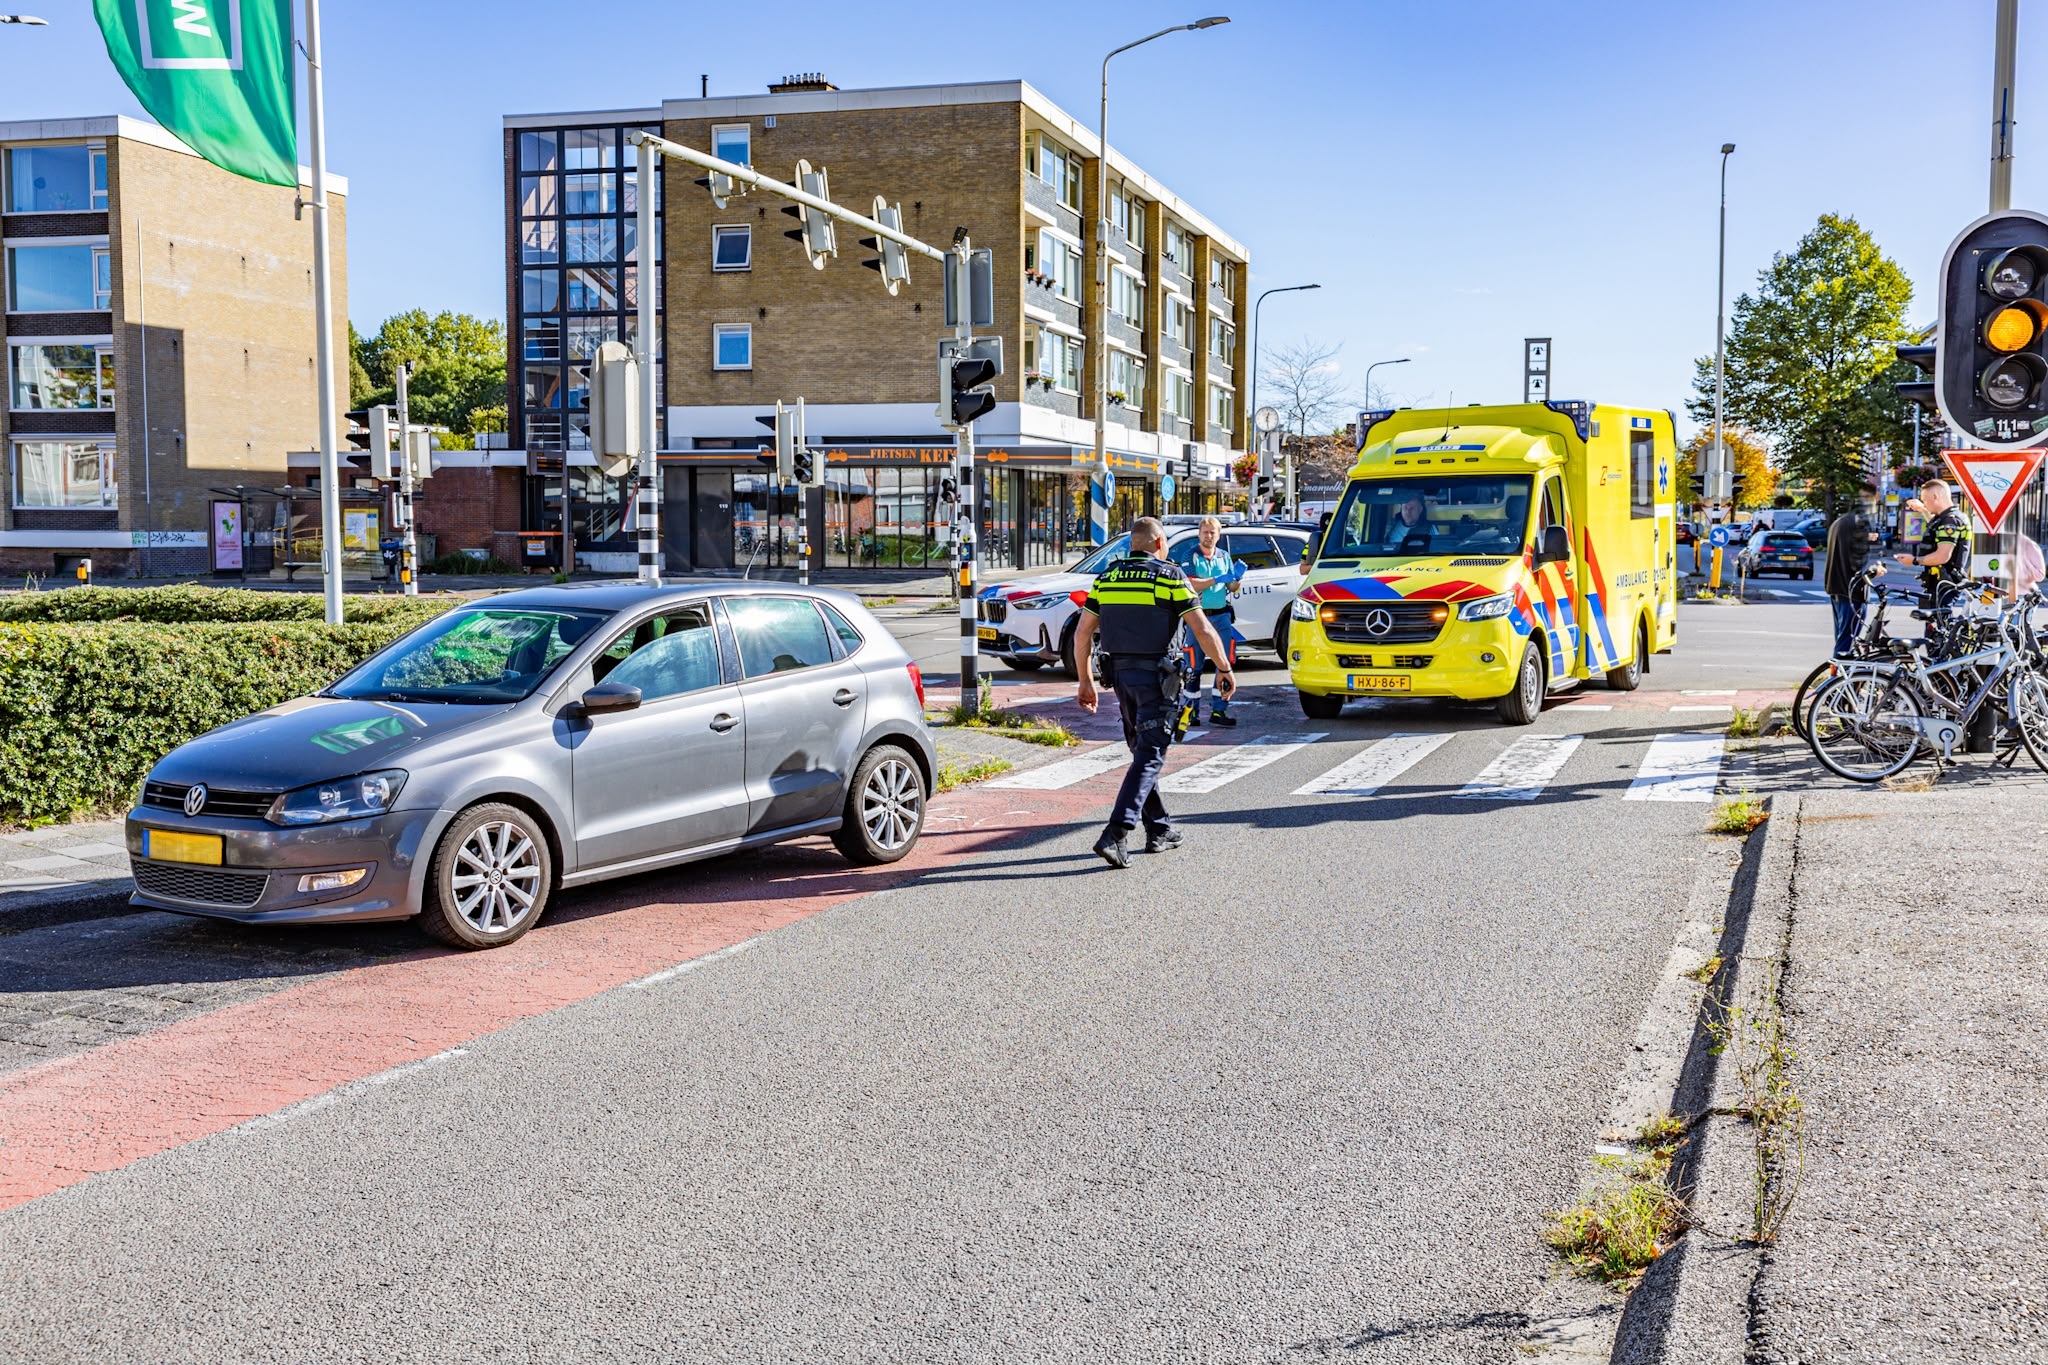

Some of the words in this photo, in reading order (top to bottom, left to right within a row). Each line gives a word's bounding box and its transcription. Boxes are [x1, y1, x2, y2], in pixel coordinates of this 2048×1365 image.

[870, 448, 917, 459] FIETSEN
[1616, 570, 1648, 588] AMBULANCE
[1357, 677, 1406, 688] HXJ-86-F
